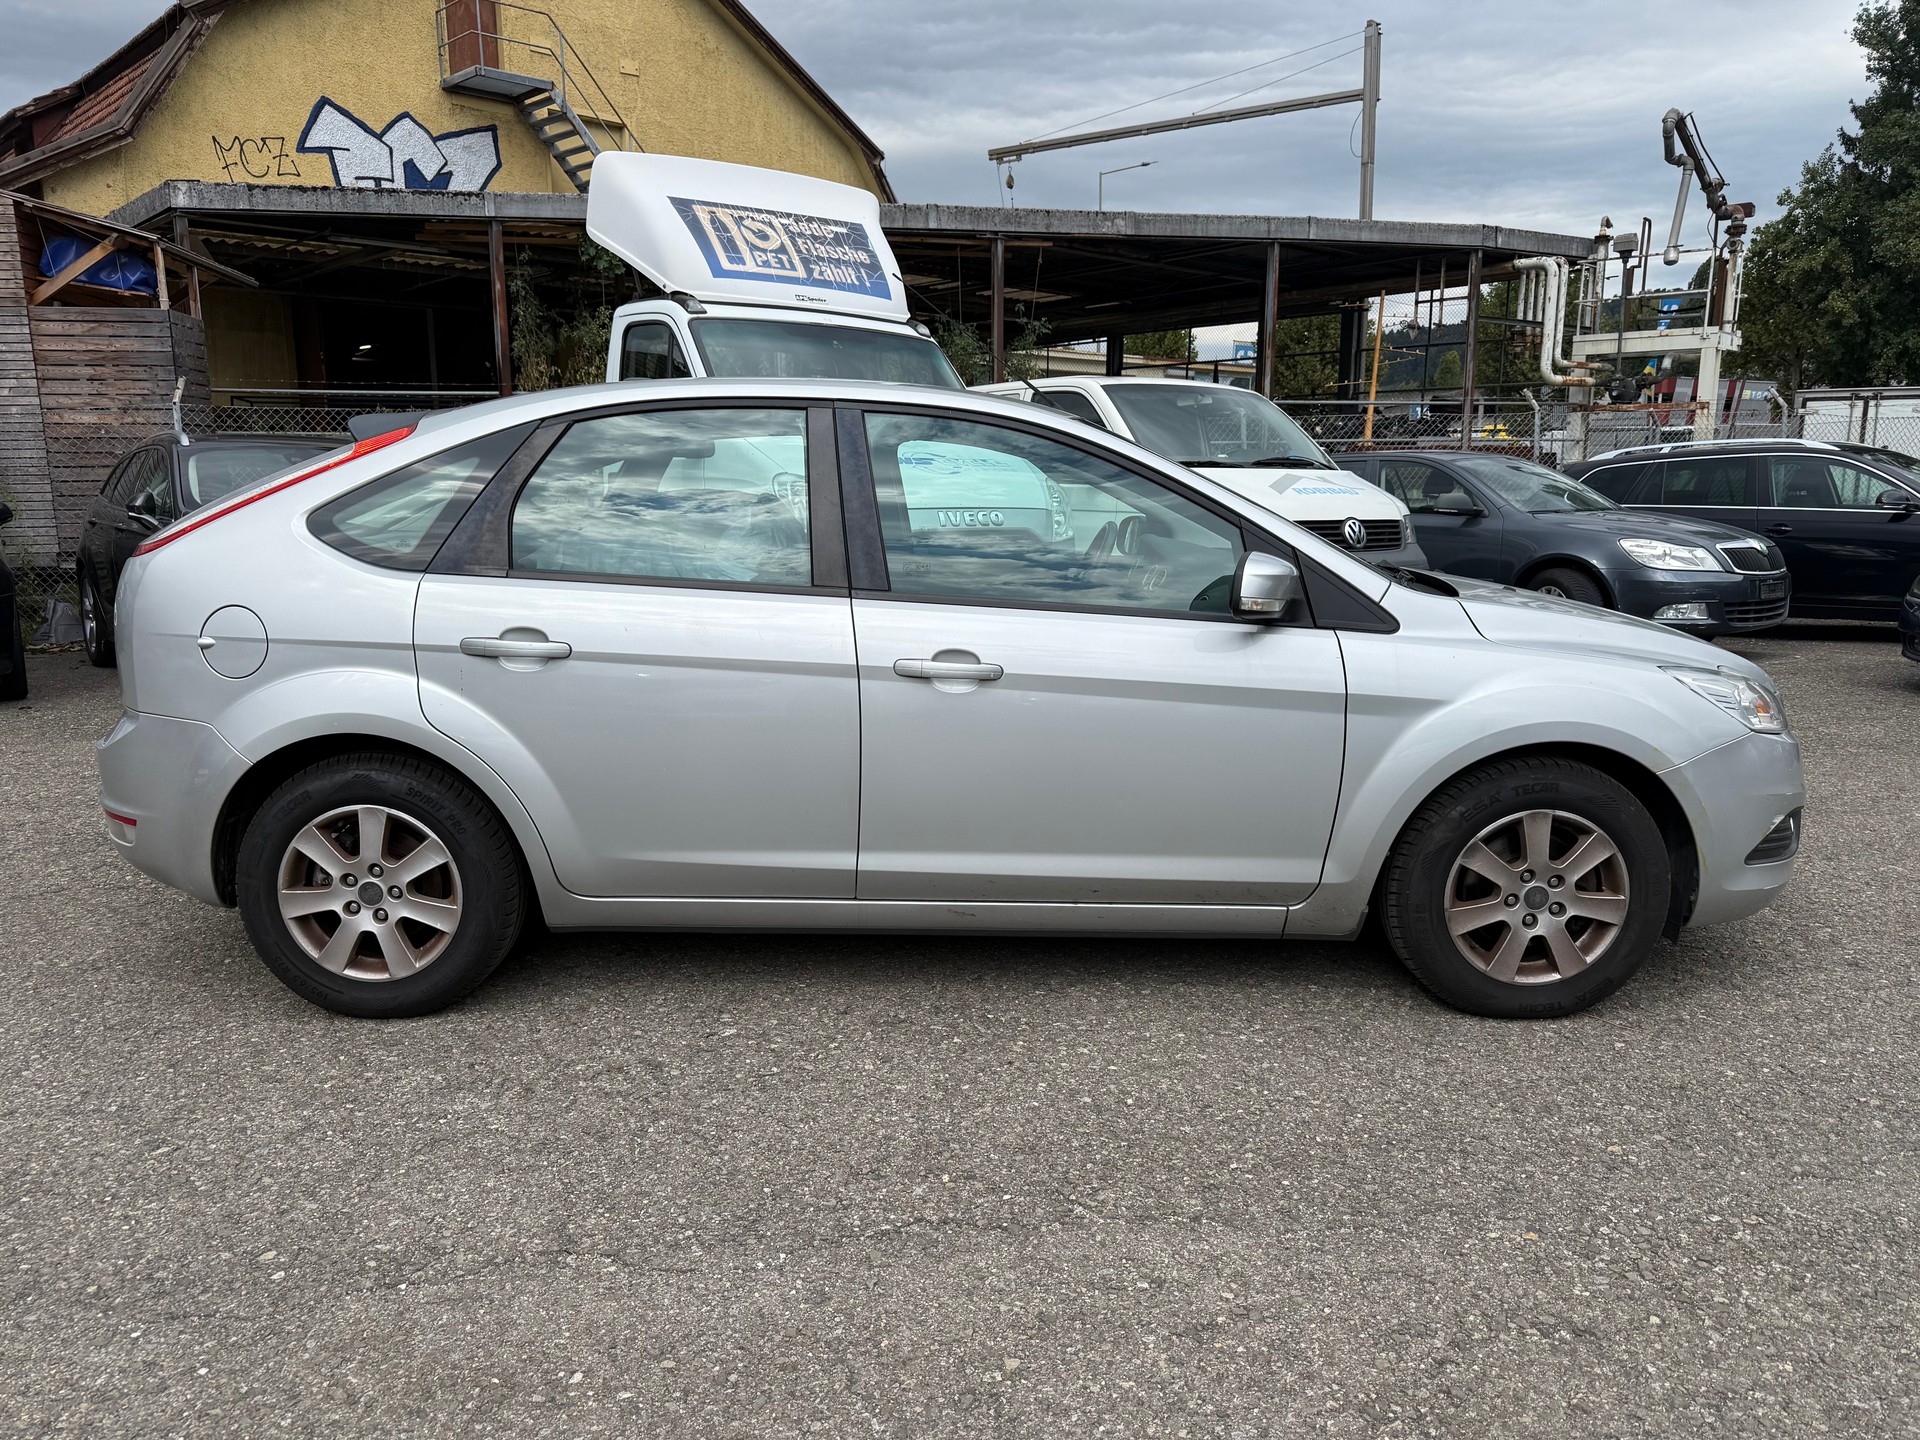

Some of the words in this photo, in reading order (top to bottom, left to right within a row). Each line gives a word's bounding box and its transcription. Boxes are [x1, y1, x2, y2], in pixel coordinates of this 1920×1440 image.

[755, 250, 793, 269] PET
[796, 238, 871, 264] Flasche
[937, 510, 1004, 527] IVECO
[404, 786, 445, 812] SPIRIT
[445, 811, 467, 836] PRO
